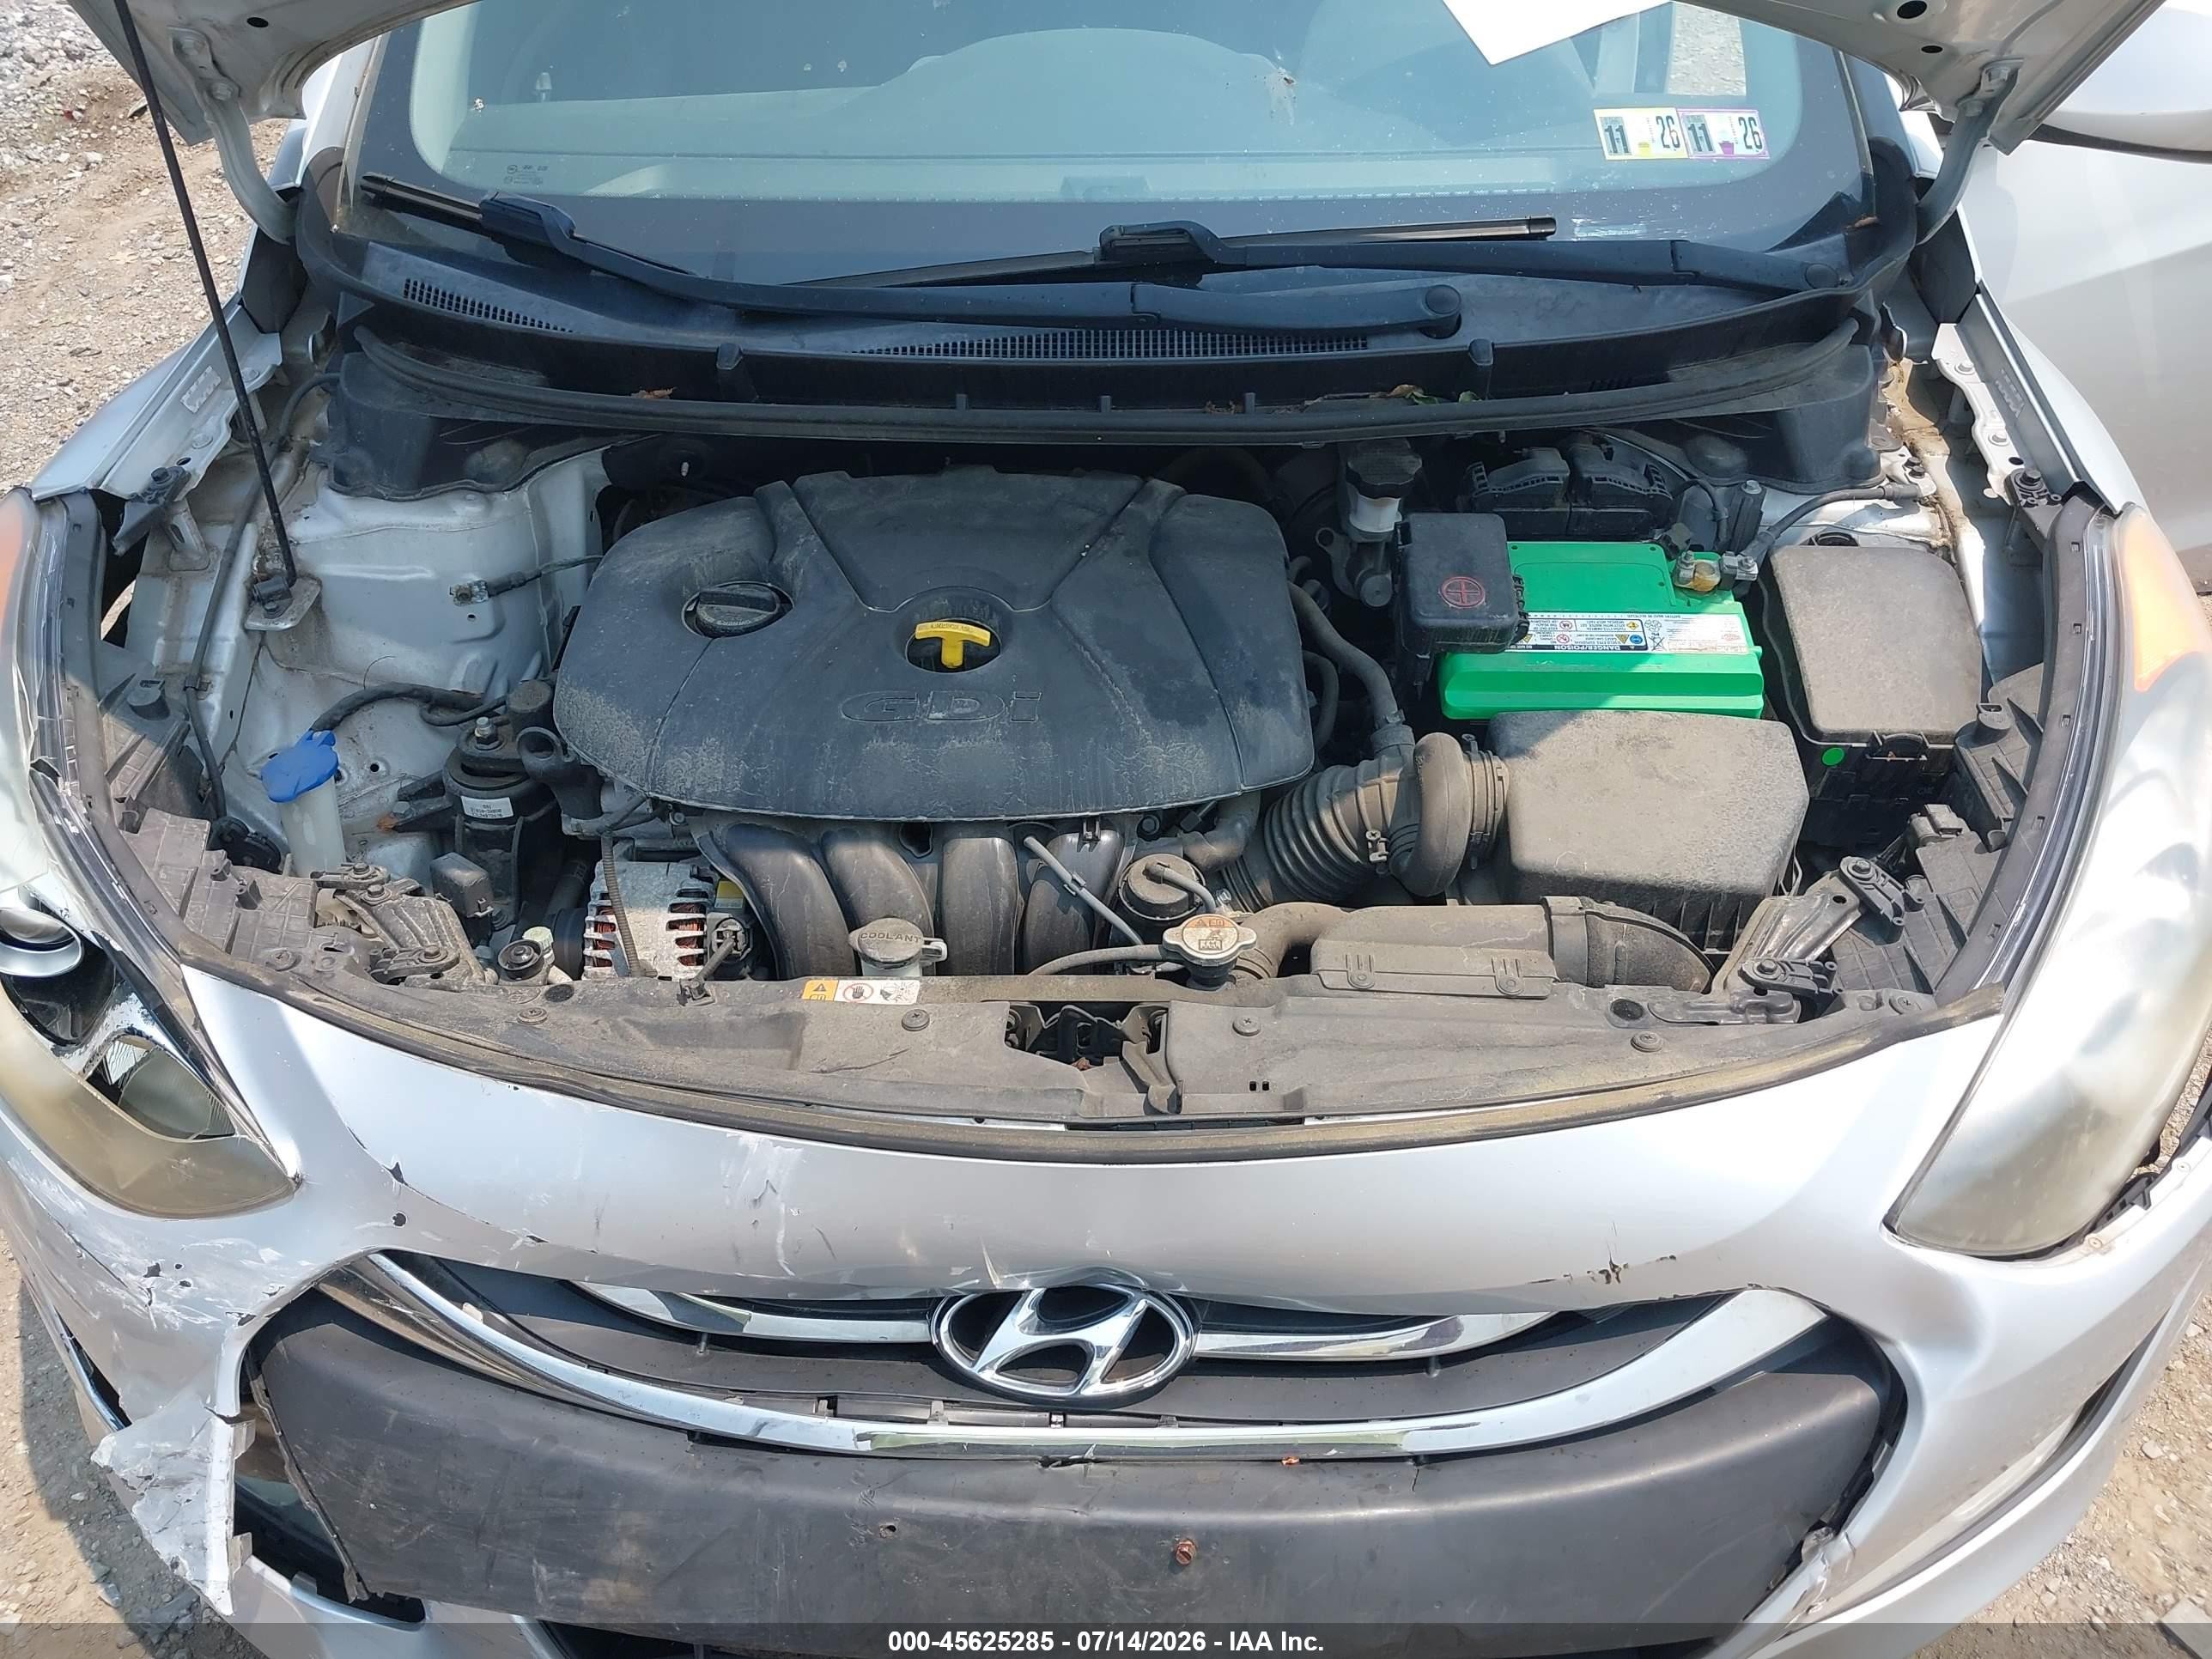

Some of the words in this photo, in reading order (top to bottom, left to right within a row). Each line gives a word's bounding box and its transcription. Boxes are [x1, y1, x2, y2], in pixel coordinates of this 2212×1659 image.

[1604, 125, 1630, 153] 11
[1656, 115, 1680, 149] 26
[1688, 123, 1714, 152] 11
[1738, 117, 1763, 149] 26
[860, 933, 921, 944] COOLANT
